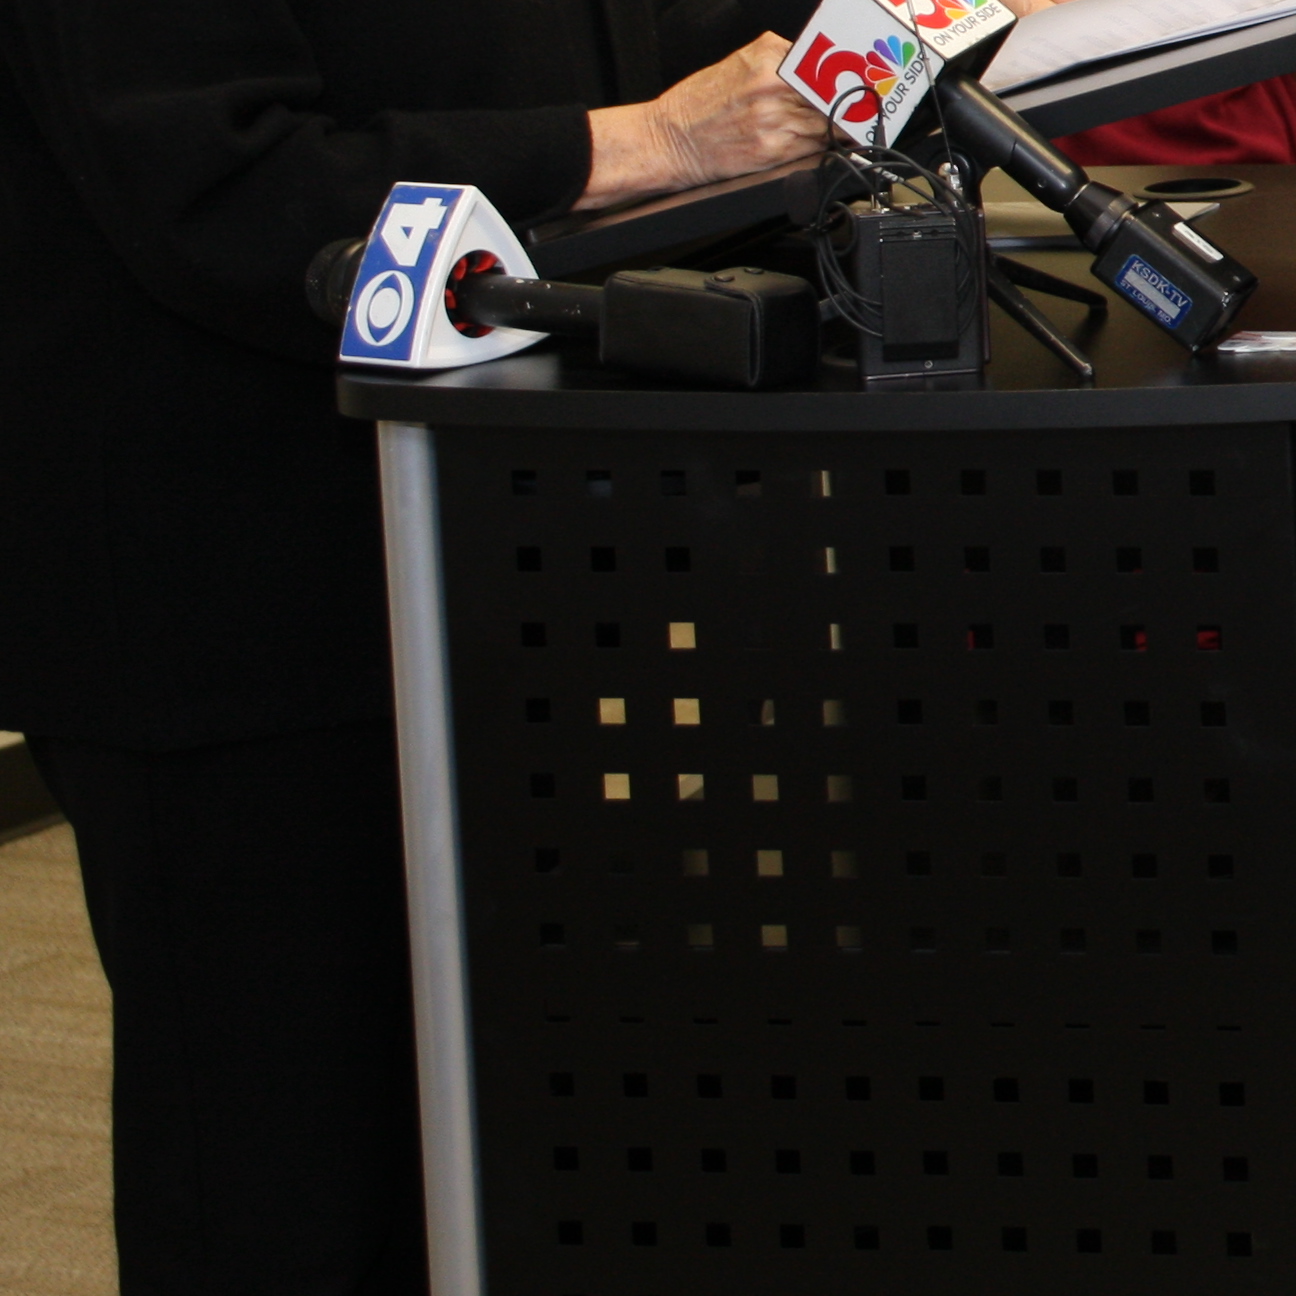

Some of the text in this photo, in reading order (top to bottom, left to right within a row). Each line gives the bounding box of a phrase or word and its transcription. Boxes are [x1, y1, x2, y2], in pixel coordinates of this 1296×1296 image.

[933, 2, 1002, 46] ON YOUR SIDE
[794, 32, 881, 123] 5
[881, 83, 910, 122] YOUR
[381, 197, 447, 266] 4
[1131, 260, 1188, 307] KSDK-TV
